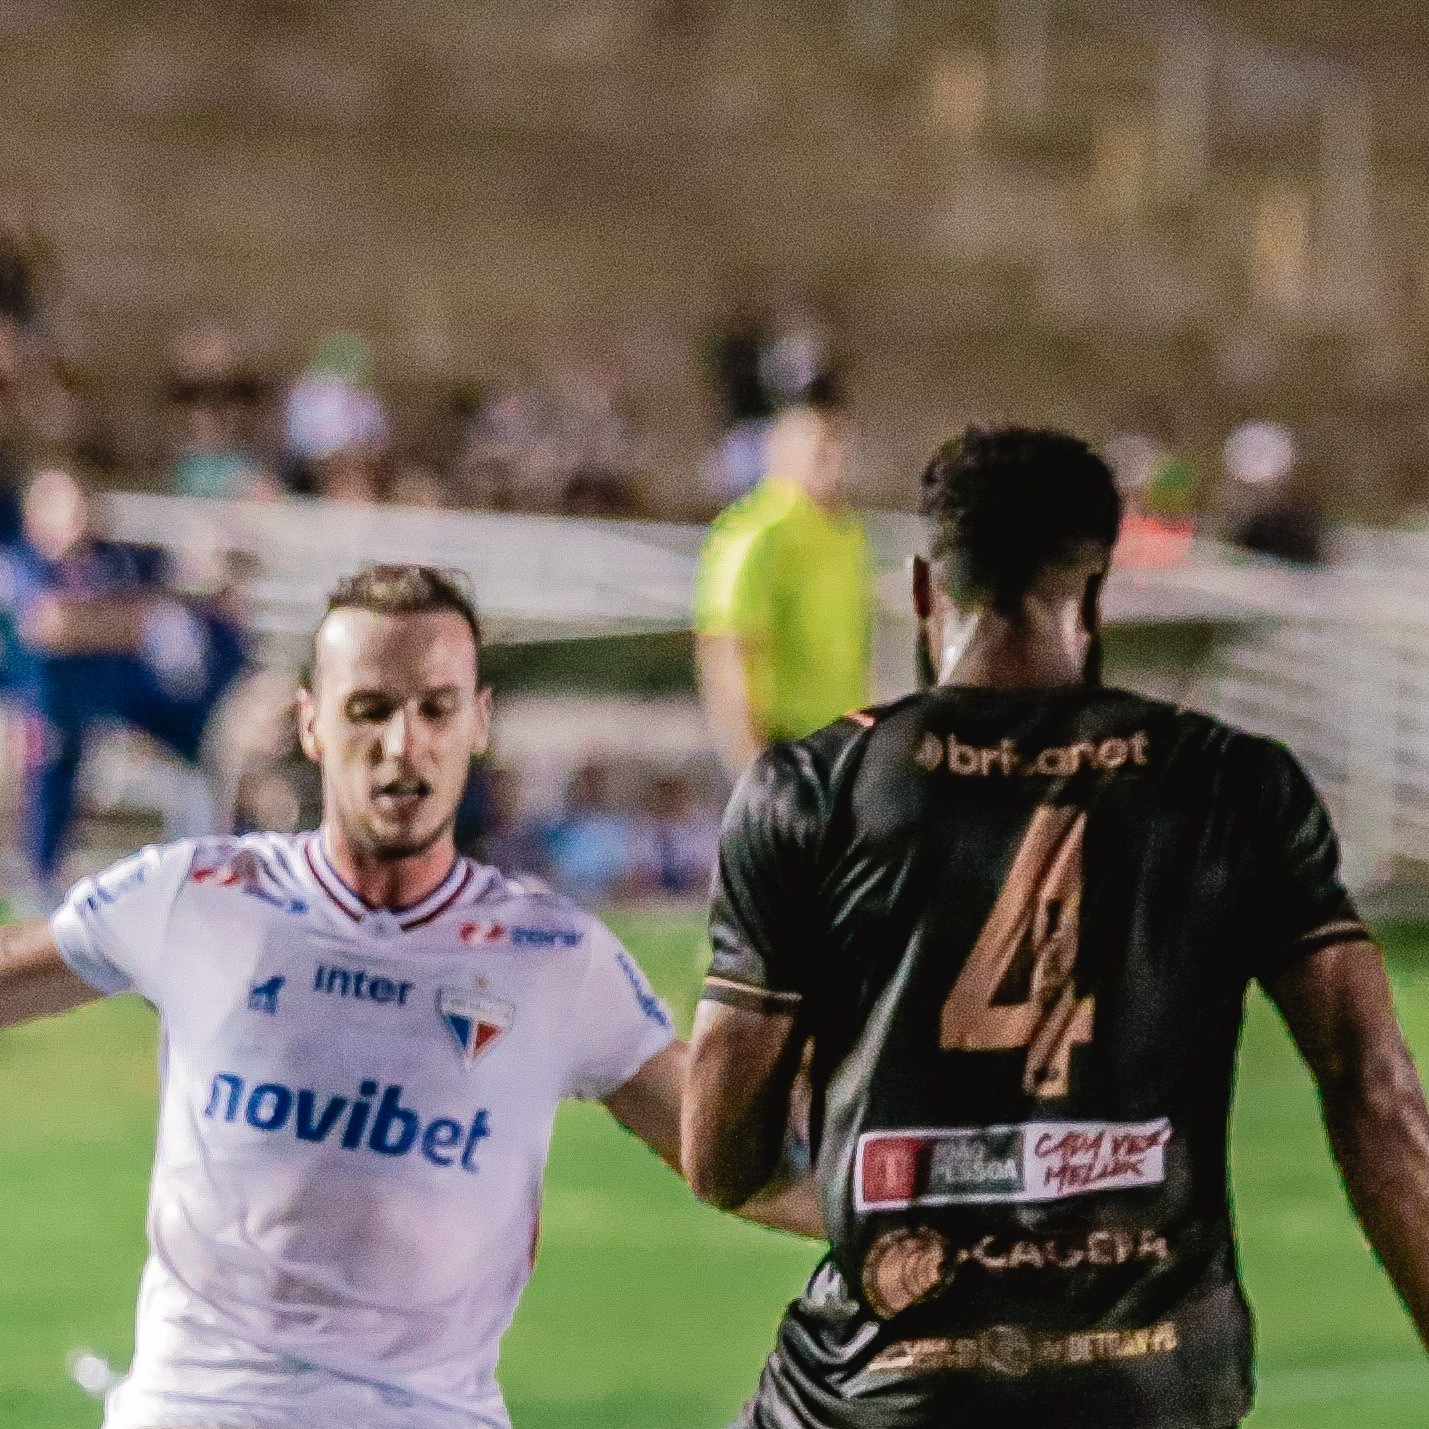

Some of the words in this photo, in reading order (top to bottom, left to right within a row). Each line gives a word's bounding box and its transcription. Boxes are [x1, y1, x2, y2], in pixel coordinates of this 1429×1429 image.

[312, 963, 416, 1006] inter
[939, 804, 1094, 1098] 4
[203, 1072, 491, 1173] novibet
